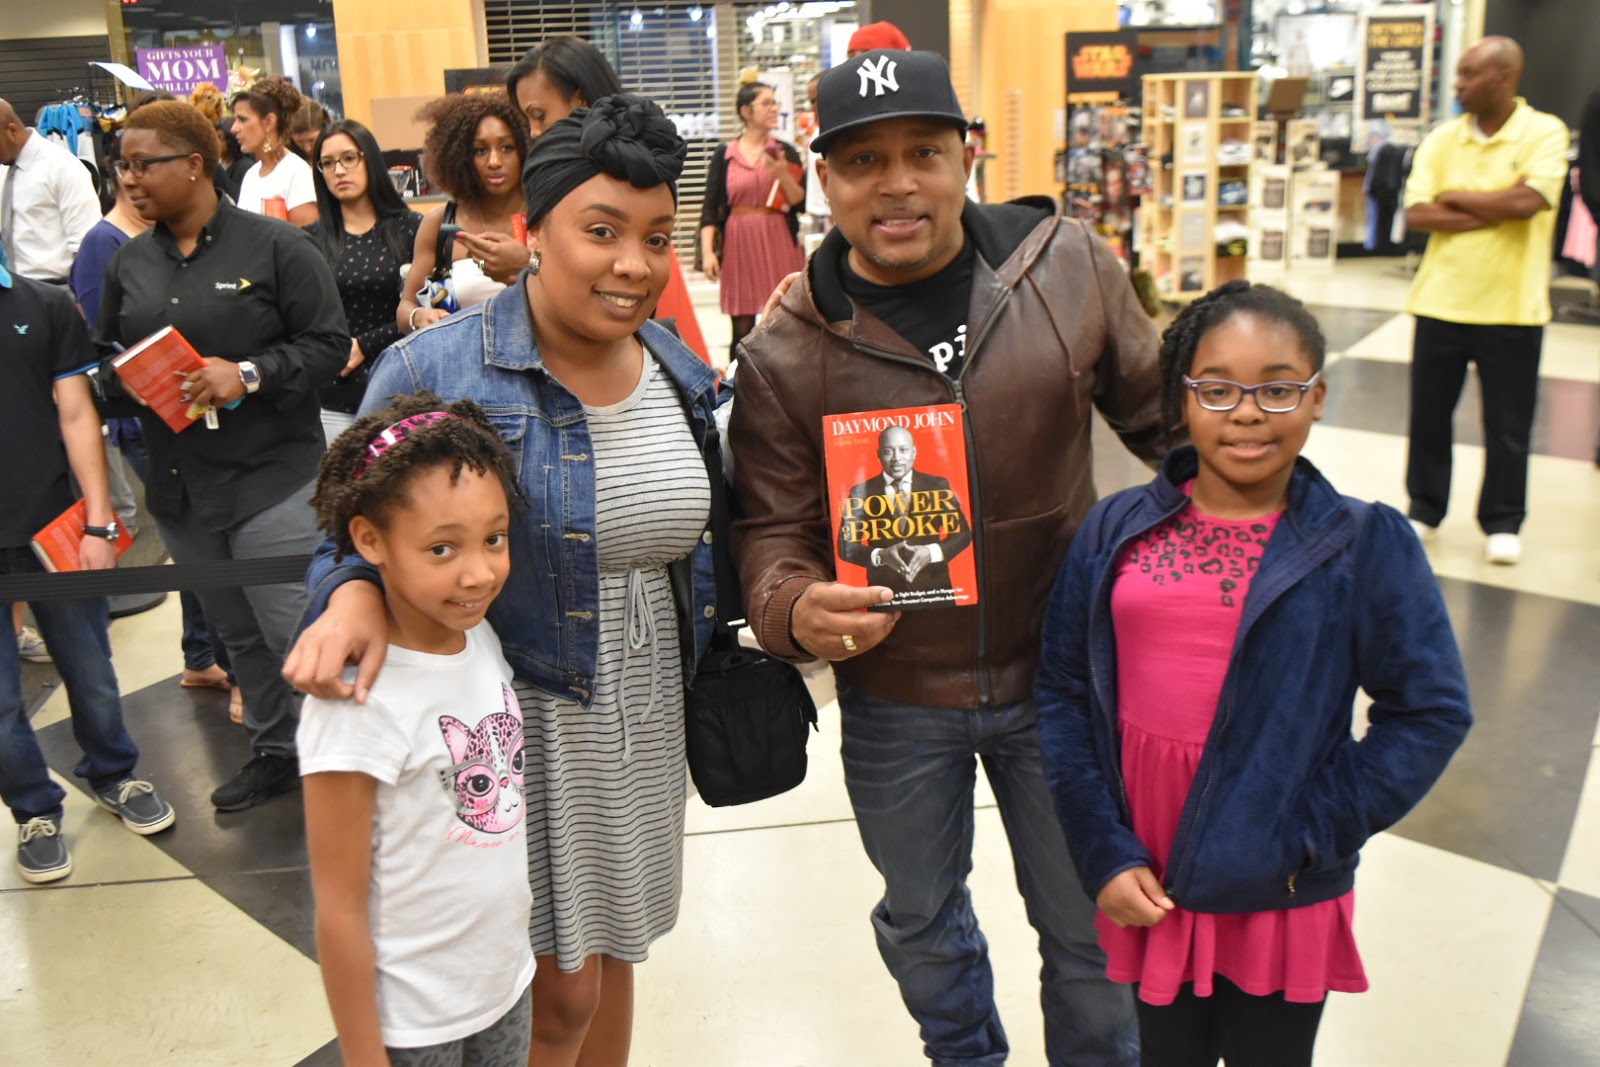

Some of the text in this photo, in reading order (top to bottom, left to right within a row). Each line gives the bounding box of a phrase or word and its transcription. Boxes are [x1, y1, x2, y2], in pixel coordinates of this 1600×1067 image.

[146, 48, 214, 60] GIFTS YOUR
[145, 58, 221, 82] MOM
[856, 54, 900, 98] NY
[832, 411, 955, 436] DAYMOND JOHN
[843, 489, 957, 520] POWER
[848, 512, 961, 543] BROKE
